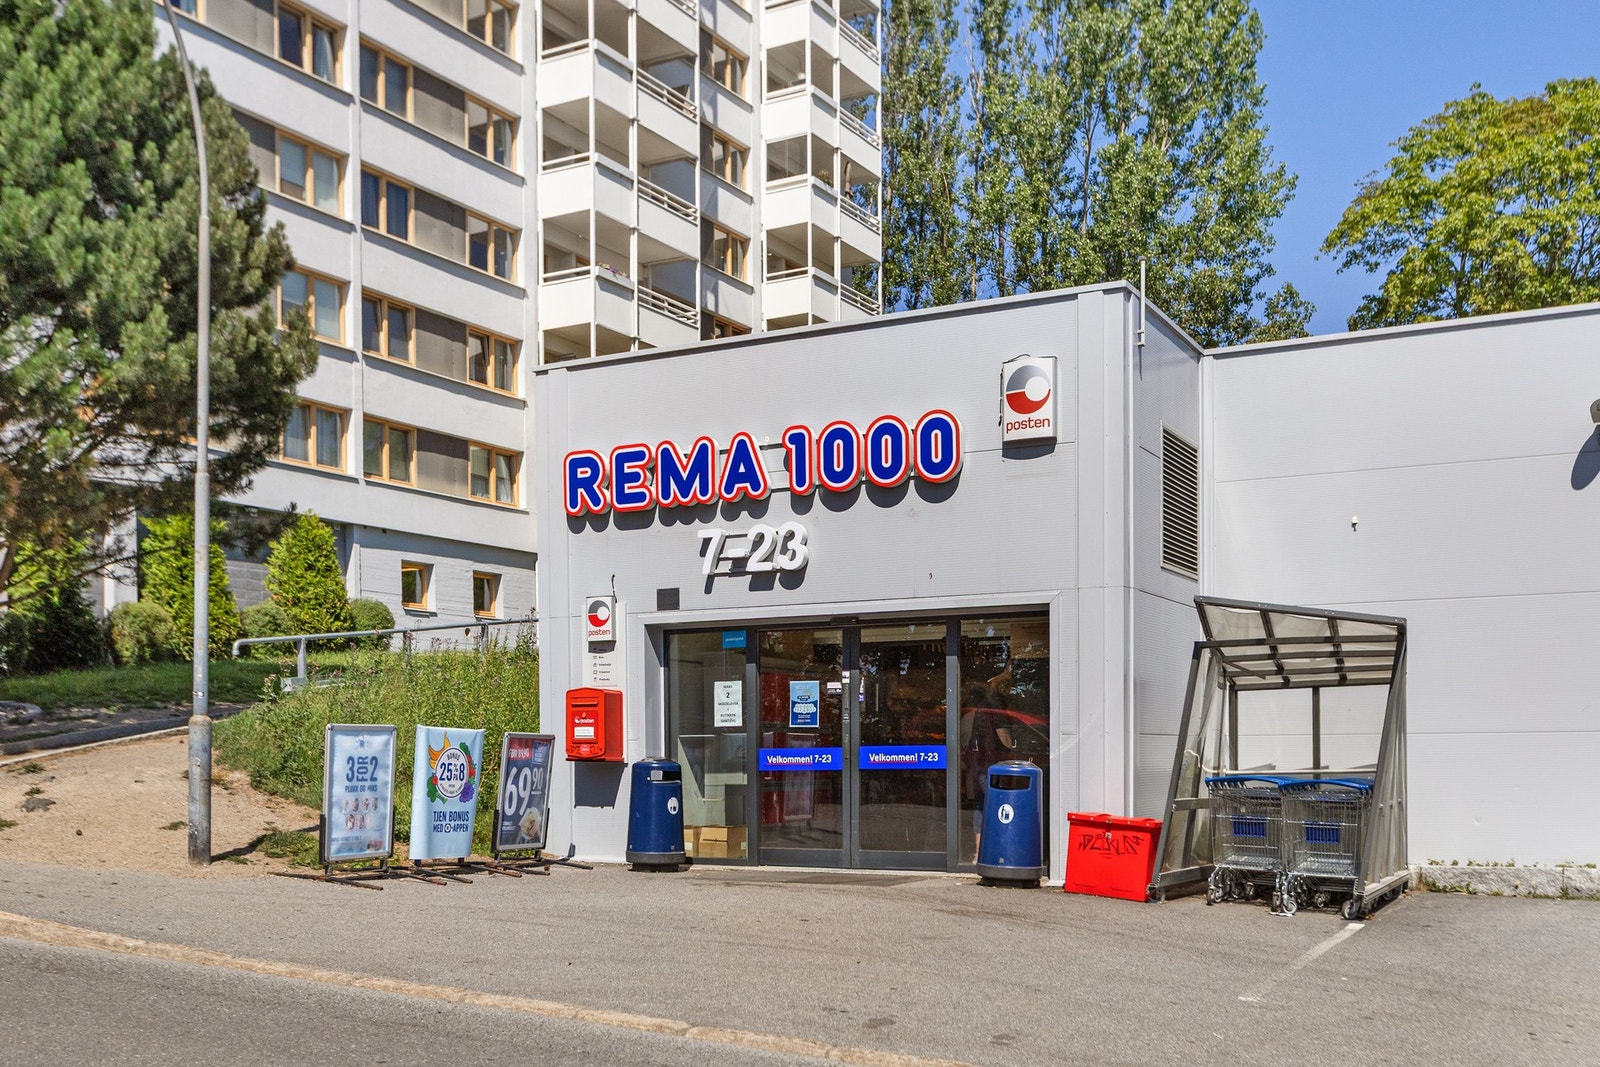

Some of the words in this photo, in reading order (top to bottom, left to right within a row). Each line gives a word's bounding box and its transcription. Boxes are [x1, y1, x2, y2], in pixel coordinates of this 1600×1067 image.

[1006, 417, 1051, 434] posten
[563, 431, 771, 517] REMA
[781, 409, 961, 496] 1000
[697, 521, 808, 575] 7-23
[588, 629, 611, 637] posten
[447, 752, 461, 761] BONUS
[767, 755, 813, 764] Velkommen!
[815, 754, 832, 763] 7-23
[869, 753, 918, 762] Velkommen!
[920, 752, 938, 761] 7-23
[346, 756, 355, 783] 3
[356, 756, 369, 782] FOR
[369, 756, 378, 782] 2
[439, 762, 453, 781] 25
[459, 763, 465, 781] 8
[345, 785, 358, 793] PLUKK
[504, 767, 532, 816] 69
[532, 768, 544, 790] 90
[433, 811, 447, 822] TJEN
[448, 811, 470, 822] BONUS
[433, 823, 444, 833] MED
